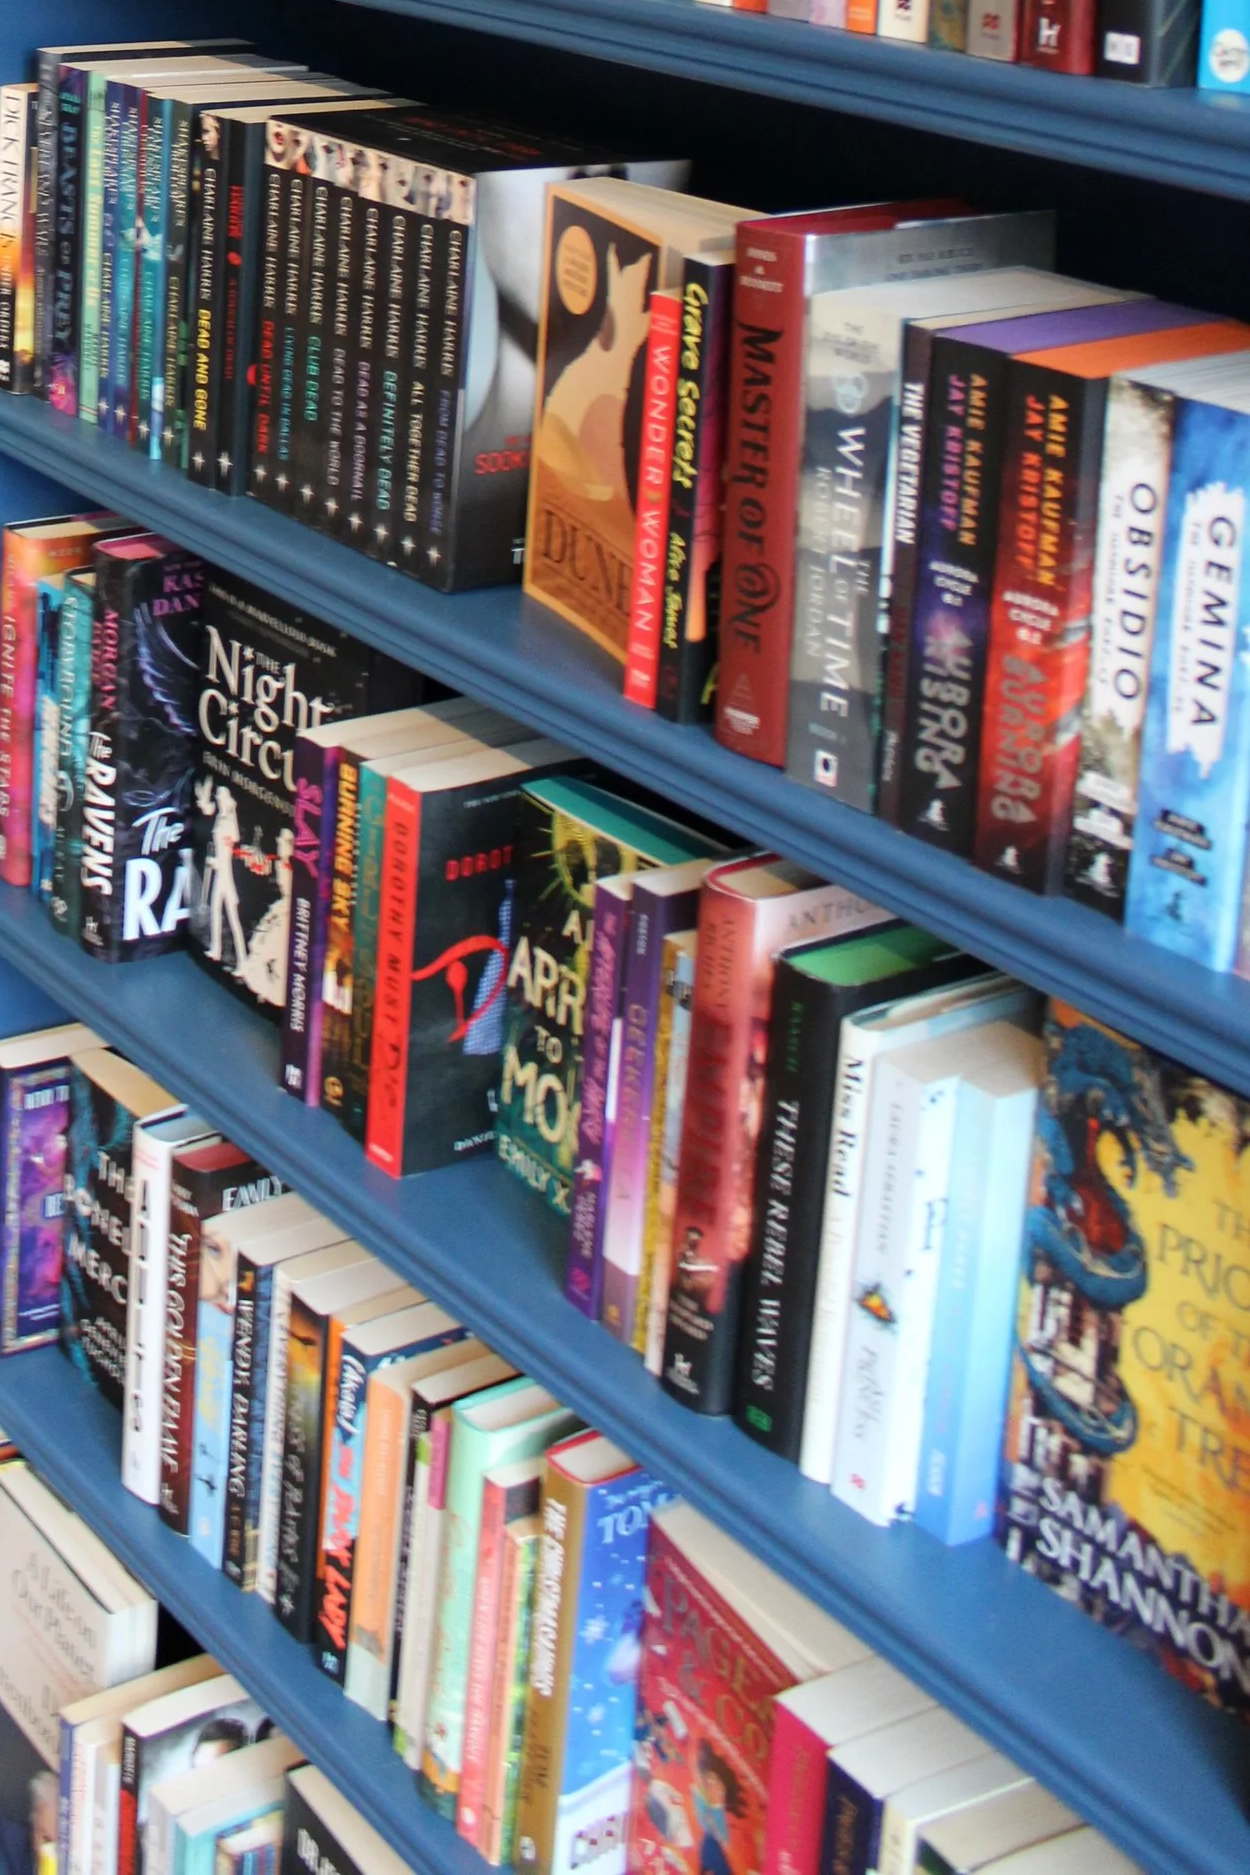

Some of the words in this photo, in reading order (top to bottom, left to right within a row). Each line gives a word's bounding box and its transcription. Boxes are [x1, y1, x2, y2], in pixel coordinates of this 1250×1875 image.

[680, 281, 711, 367] Grave
[642, 344, 673, 487] WONDER
[671, 377, 702, 489] Secrets
[737, 321, 785, 490] MASTER
[902, 382, 926, 421] THE
[947, 373, 966, 417] JAY
[966, 373, 989, 430] AMIE
[829, 427, 868, 577] WHEEL
[895, 425, 923, 545] VEGETARIAN
[939, 425, 965, 531] KRISTOFF
[958, 438, 985, 546] KAUFMAN
[634, 508, 663, 635] WOMAN
[1113, 481, 1159, 702] OBSIDIO
[1190, 514, 1237, 727] GEMINA
[819, 611, 859, 718] TIME
[80, 756, 118, 896] RAVENS
[293, 776, 323, 876] SLAY
[840, 1056, 865, 1115] Miss
[832, 1123, 855, 1198] Read
